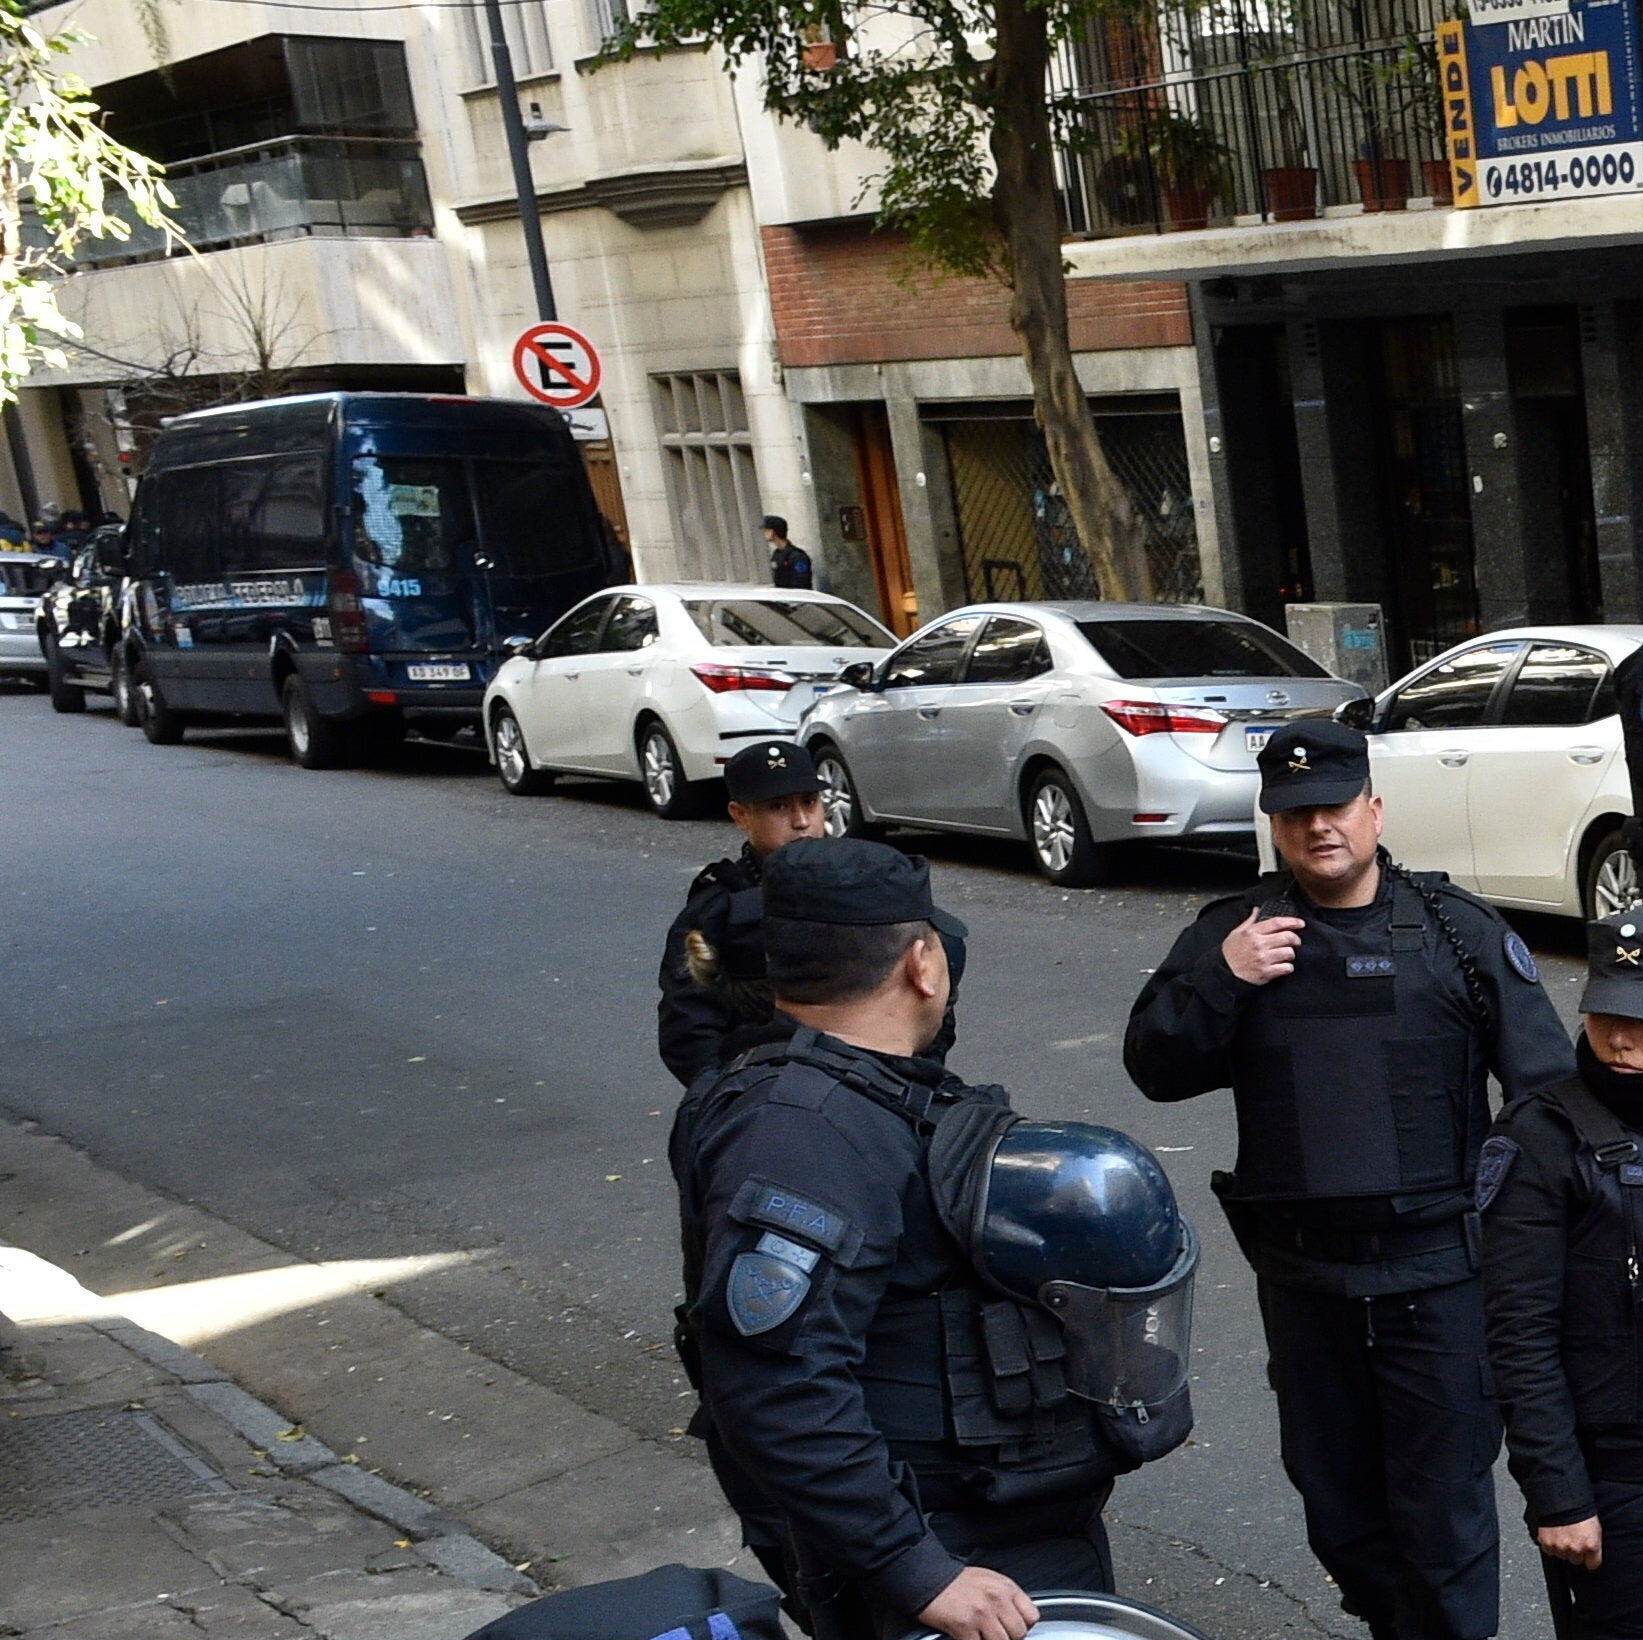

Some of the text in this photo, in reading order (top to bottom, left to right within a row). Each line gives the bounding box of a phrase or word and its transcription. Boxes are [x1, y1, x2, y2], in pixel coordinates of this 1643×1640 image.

[1507, 11, 1585, 52] MARTIN
[1490, 50, 1613, 129] LOTTI
[1442, 31, 1473, 197] VENDE
[1497, 124, 1617, 151] BROKERS INMOBILIARIOS
[1505, 151, 1635, 195] 4814-0000
[376, 577, 422, 597] 9415
